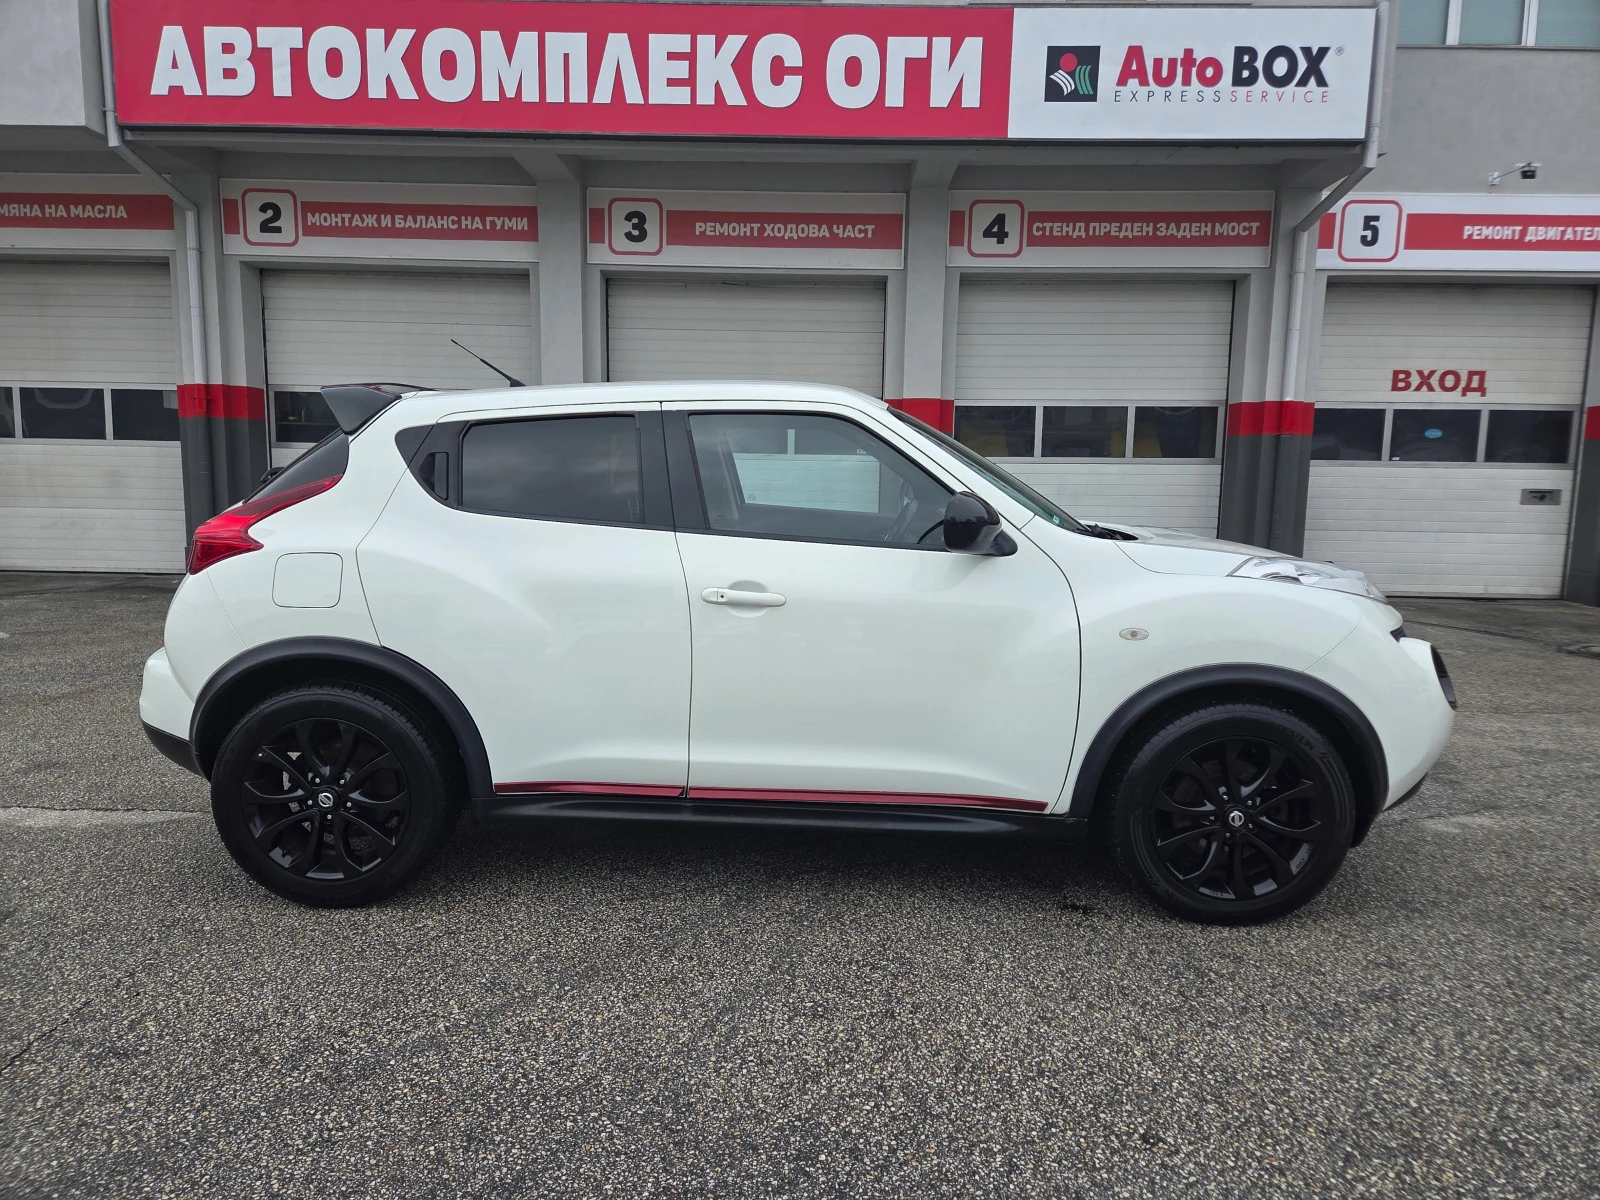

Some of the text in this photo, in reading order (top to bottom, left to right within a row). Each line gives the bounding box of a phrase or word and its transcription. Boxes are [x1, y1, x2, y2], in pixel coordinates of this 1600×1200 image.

[150, 25, 984, 109] АВТОКОМПЛЕКС ОГИ
[44, 204, 68, 219] НА
[70, 204, 128, 219] МАСЛА
[258, 201, 282, 234] 2
[307, 212, 529, 231] МОНТАЖ И БАЛАНС НА ГУМИ
[623, 210, 648, 243] 3
[695, 222, 876, 240] РЕМОНТ ХОДОВА ЧАСТ
[982, 212, 1009, 245] 4
[1032, 221, 1261, 239] СТЕНД ПРЕДЕН ЗАДЕН МОСТ
[1360, 215, 1381, 248] 5
[1463, 225, 1522, 240] РЕМОНТ
[1390, 369, 1488, 398] ВХОД
